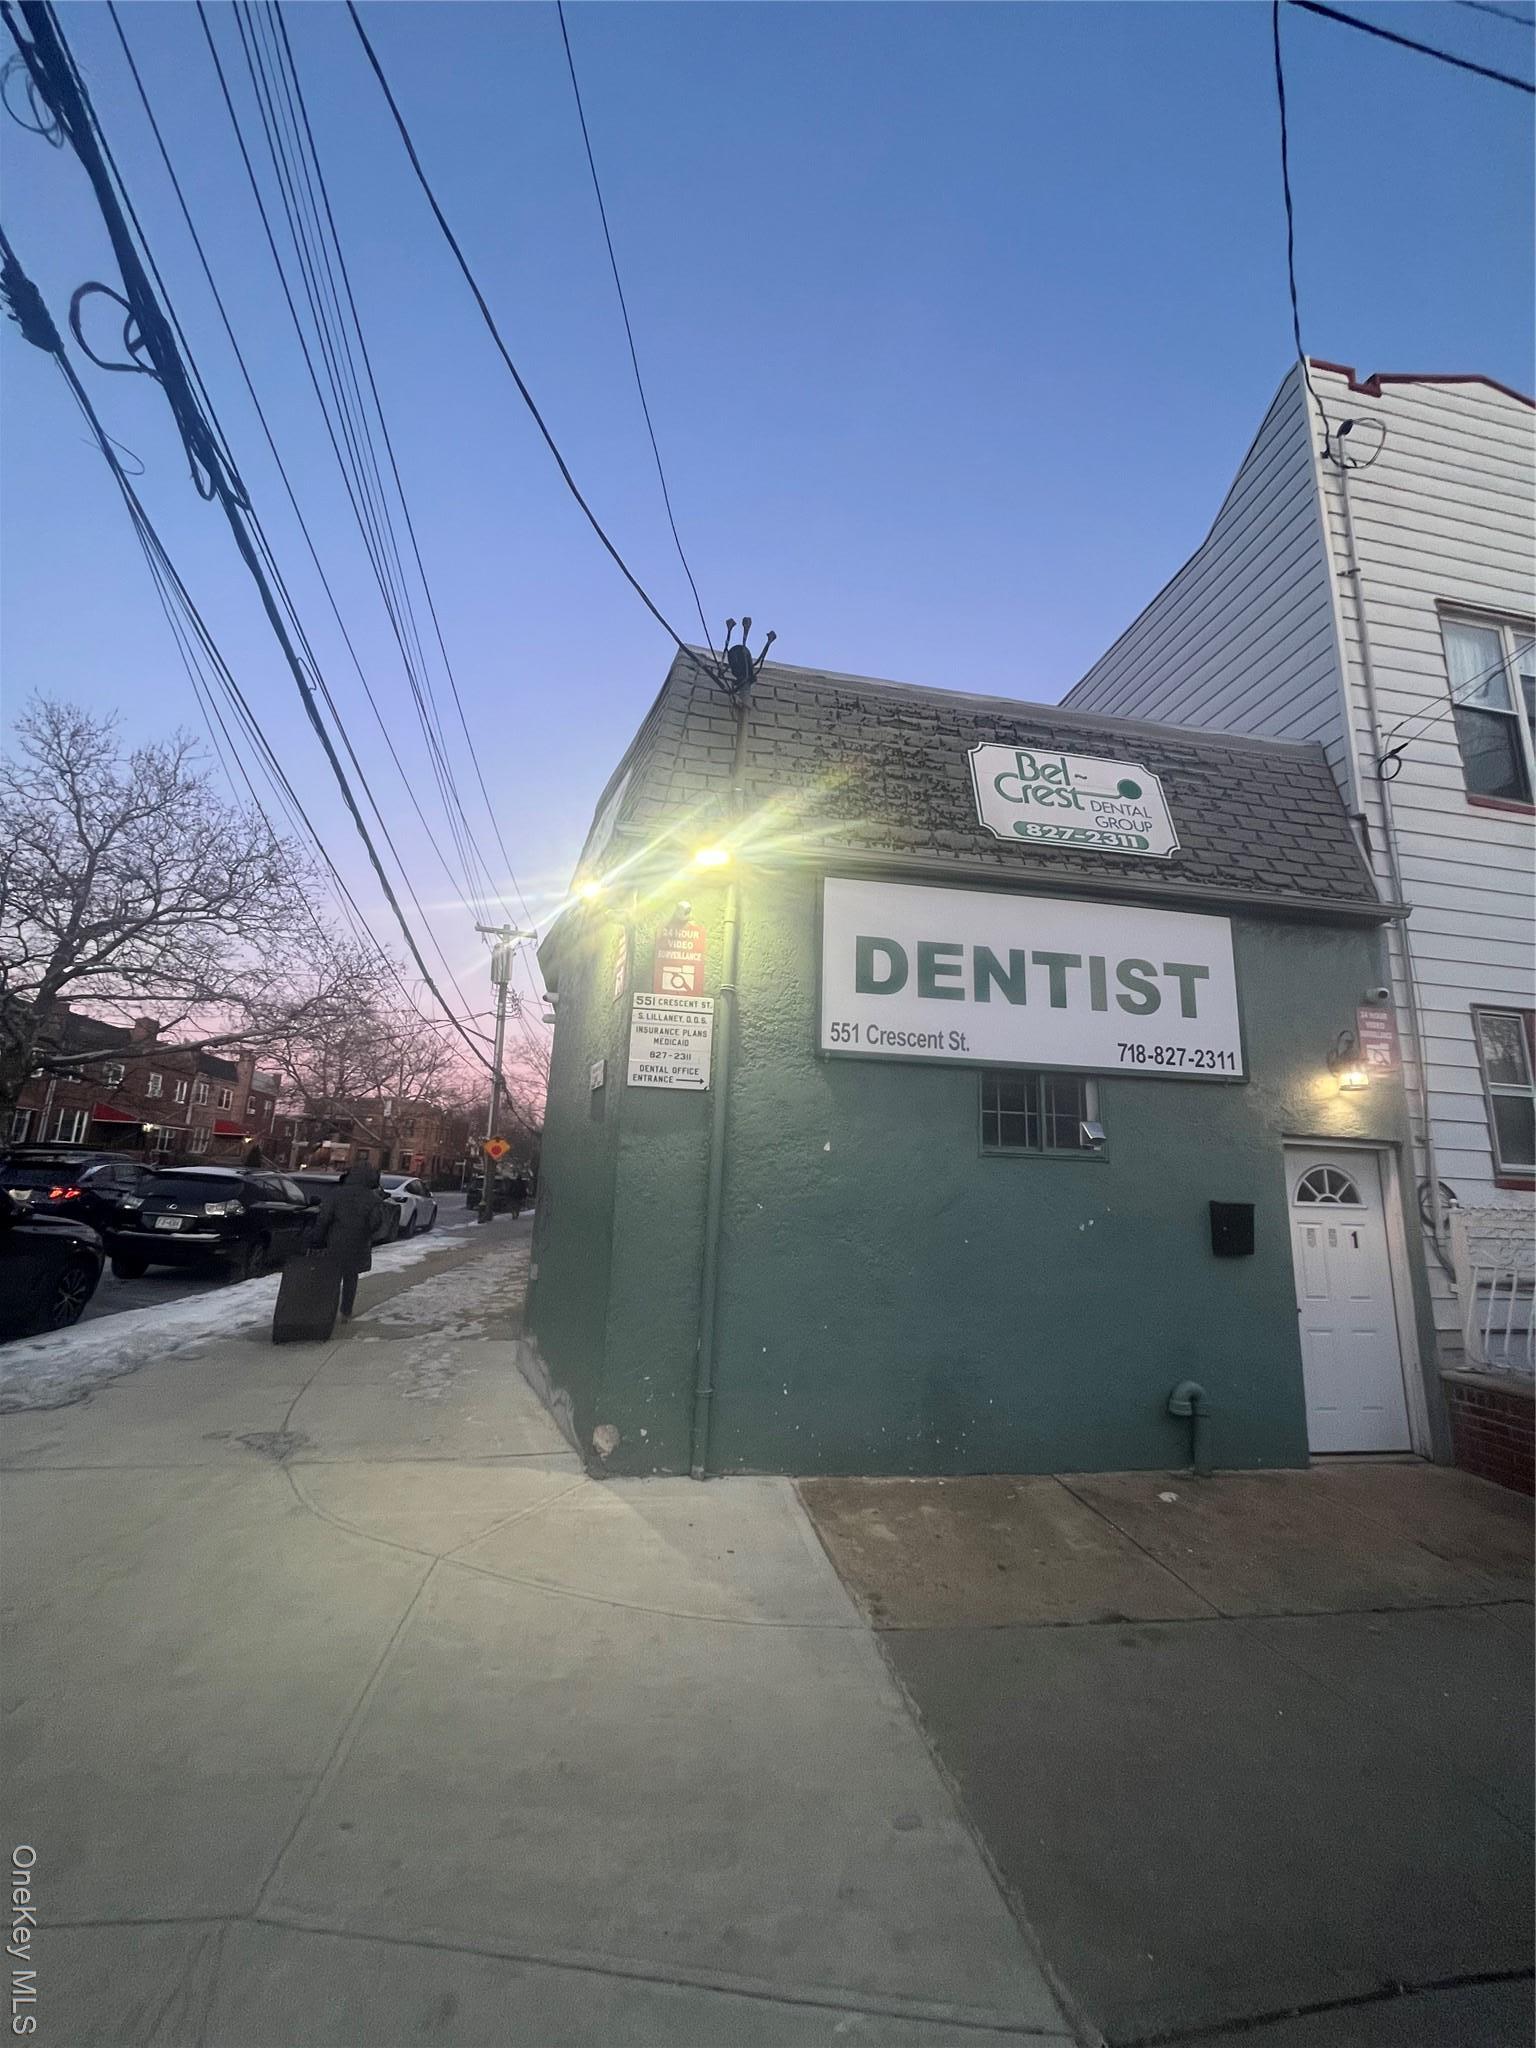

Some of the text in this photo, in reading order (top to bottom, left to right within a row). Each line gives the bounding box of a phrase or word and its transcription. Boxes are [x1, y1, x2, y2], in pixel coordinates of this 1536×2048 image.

[994, 772, 1085, 811] Crest
[1090, 800, 1153, 819] DENTAL
[1095, 815, 1153, 833] GROUP
[1026, 824, 1138, 847] 827-2311
[855, 935, 1210, 1019] DENTIST
[636, 996, 712, 1009] 551 CRESCENT ST.
[635, 1025, 708, 1038] INSURANCE PLANS
[830, 1022, 971, 1052] 551 Crescent St.
[653, 1038, 690, 1047] MEDICAID
[649, 1051, 692, 1061] 827-2311
[1117, 1042, 1236, 1070] 718-827-2311
[632, 1073, 674, 1084] ENTRANCE
[639, 1064, 700, 1076] DENTAL OFFICE
[1351, 1231, 1358, 1248] 1
